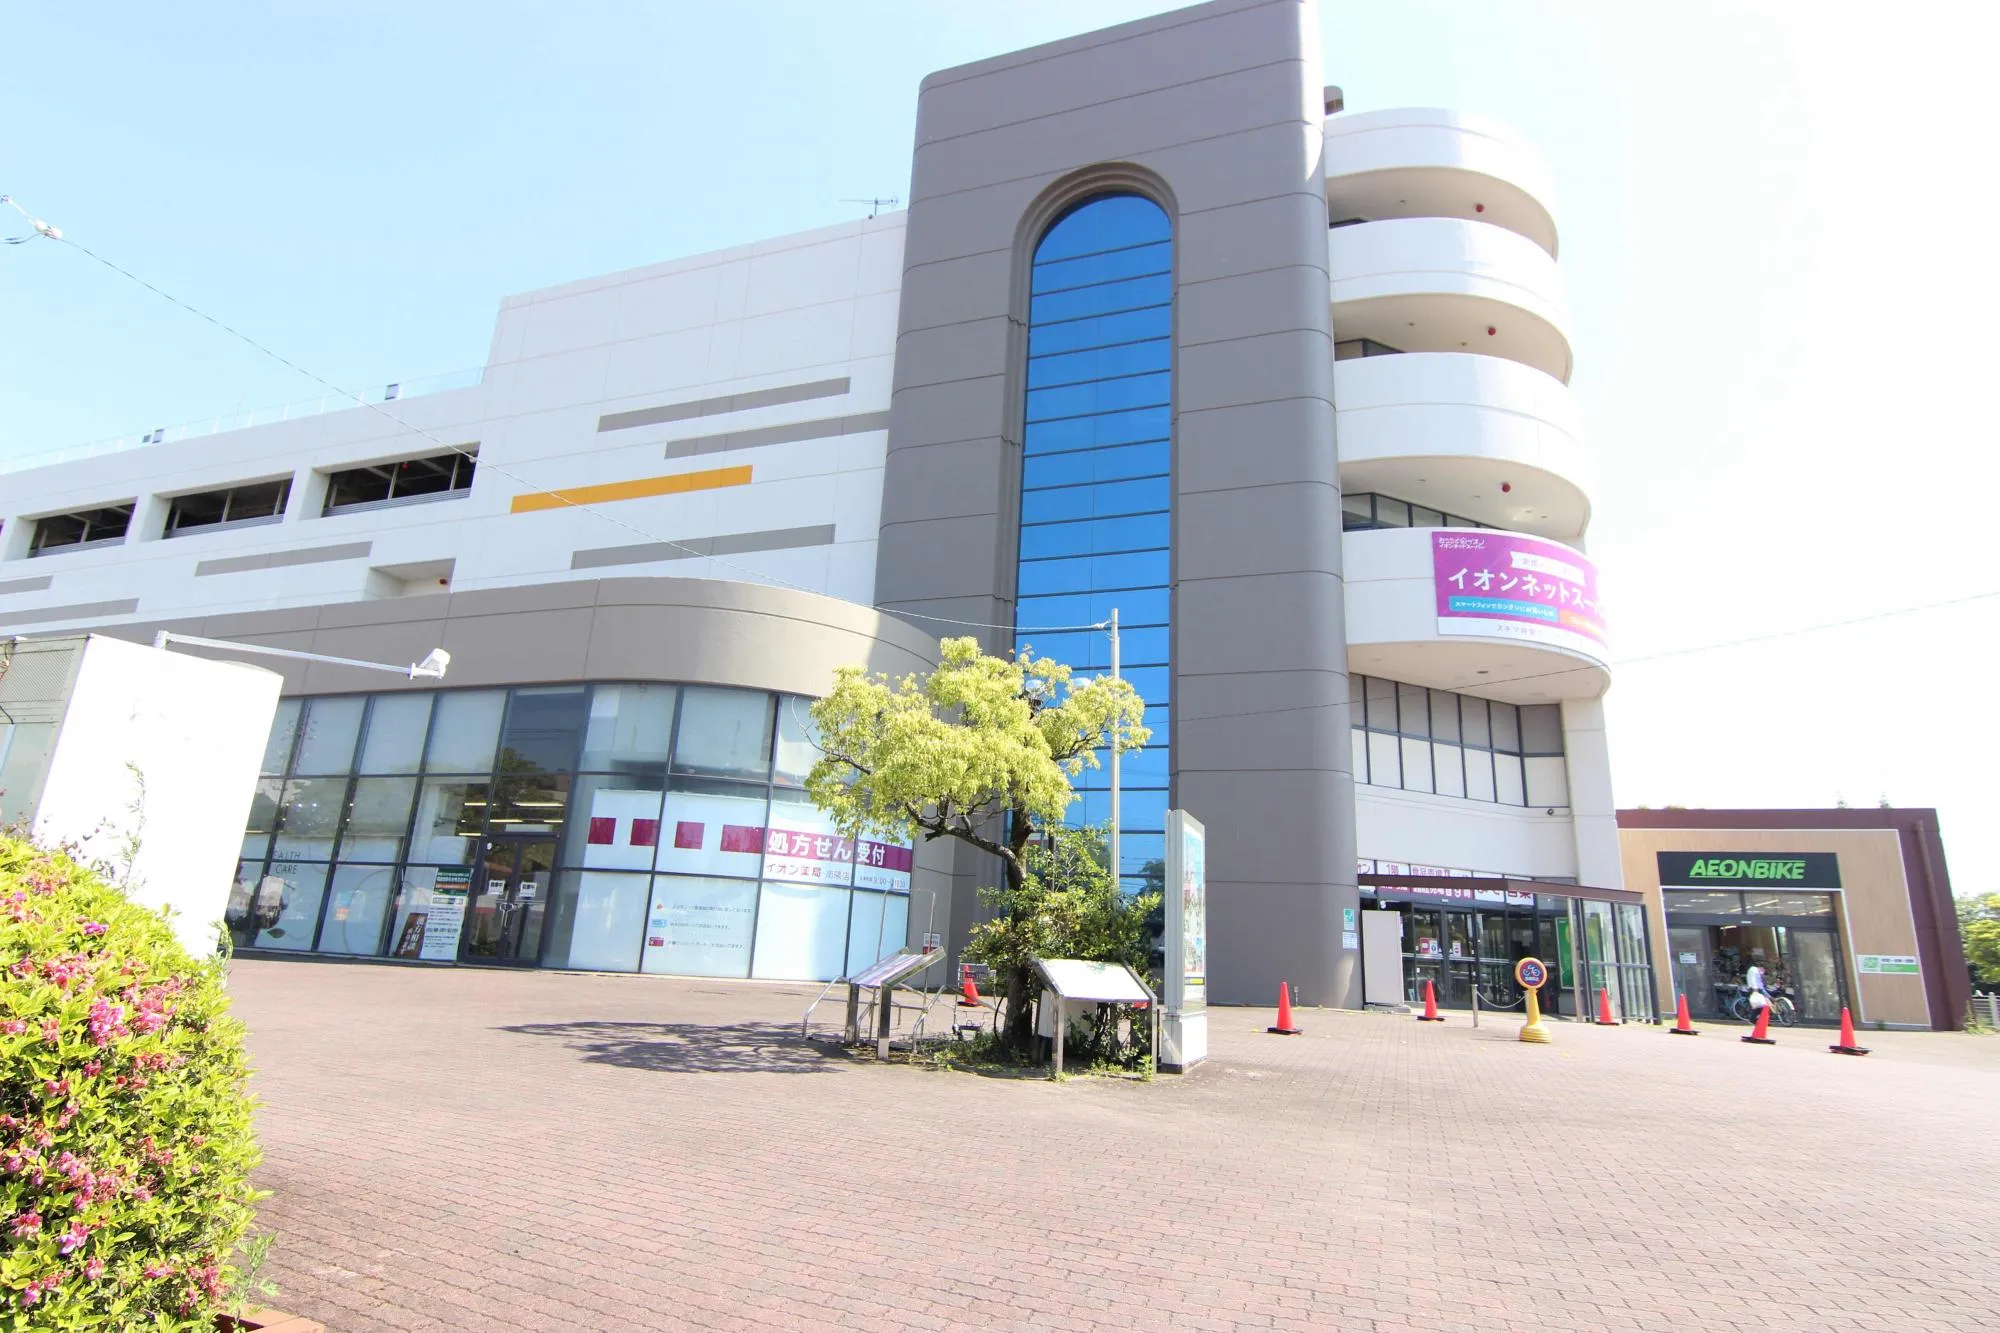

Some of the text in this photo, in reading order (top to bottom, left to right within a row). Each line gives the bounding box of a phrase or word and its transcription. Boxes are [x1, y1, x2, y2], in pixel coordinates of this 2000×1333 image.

[275, 864, 298, 875] CARE
[766, 863, 822, 878] イオン薬局
